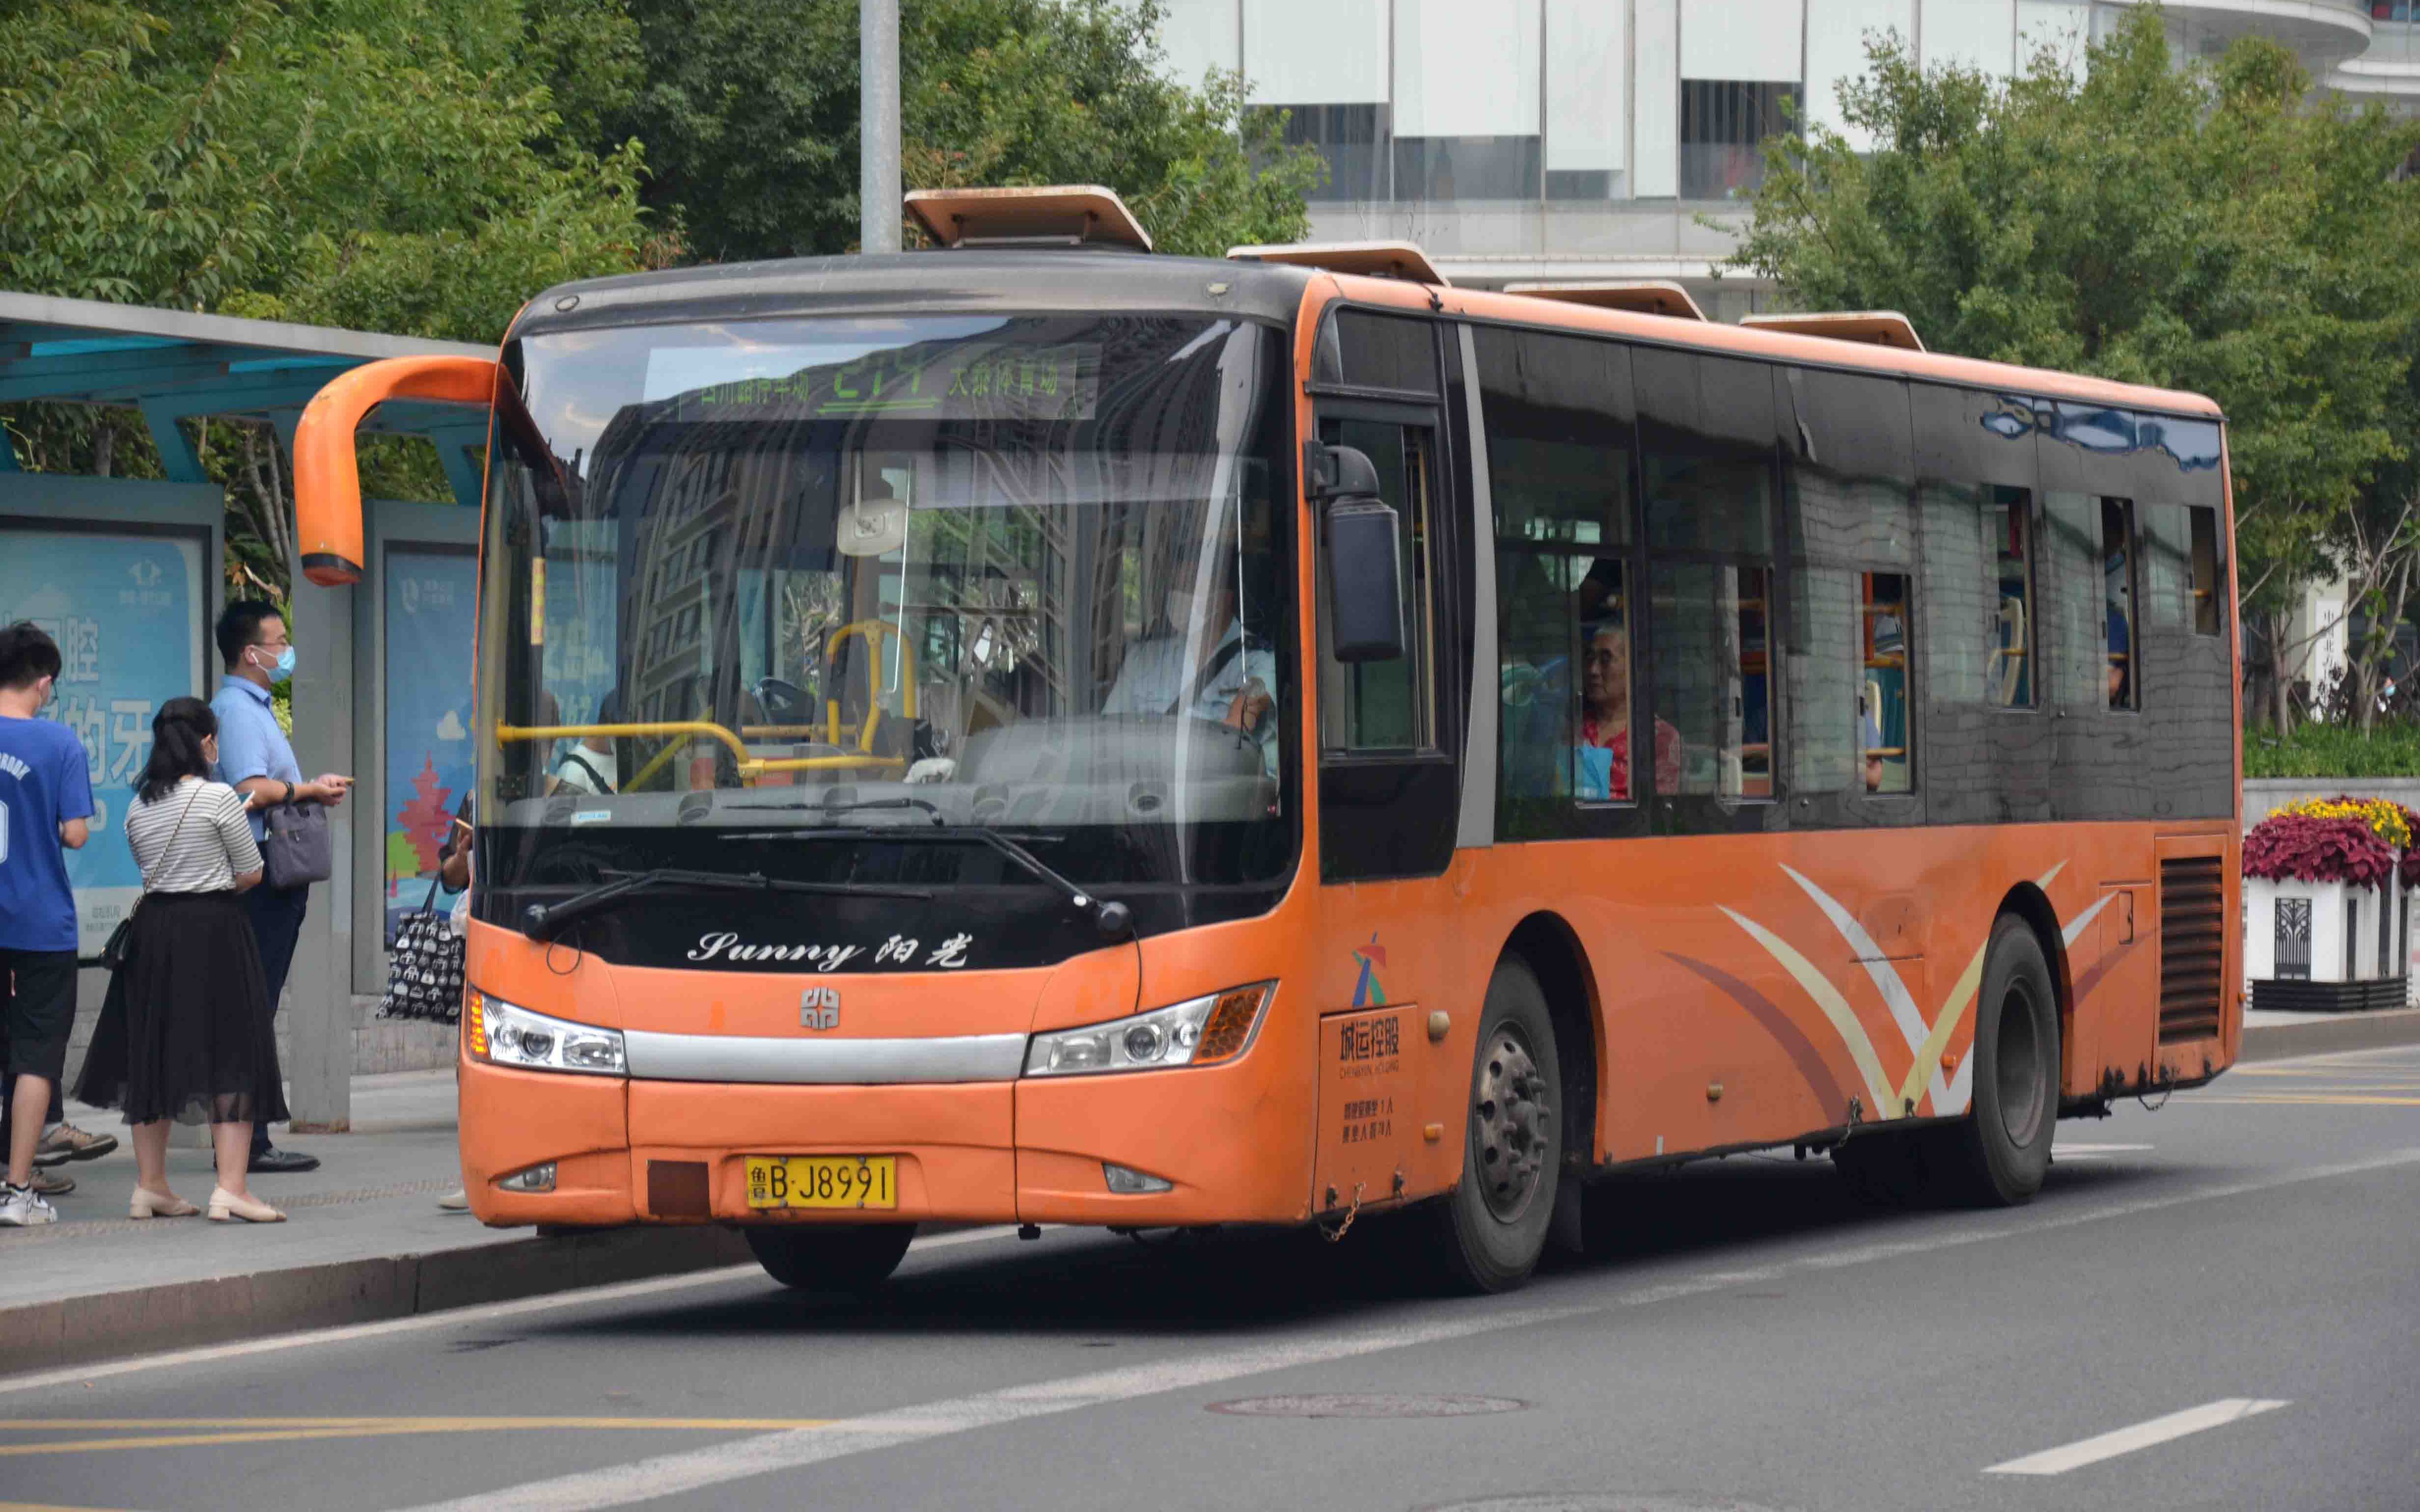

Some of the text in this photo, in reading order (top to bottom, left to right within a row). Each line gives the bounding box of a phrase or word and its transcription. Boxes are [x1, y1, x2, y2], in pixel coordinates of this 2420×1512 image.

[687, 932, 972, 972] Sunny 阳光
[1340, 1015, 1399, 1062] 城运控股
